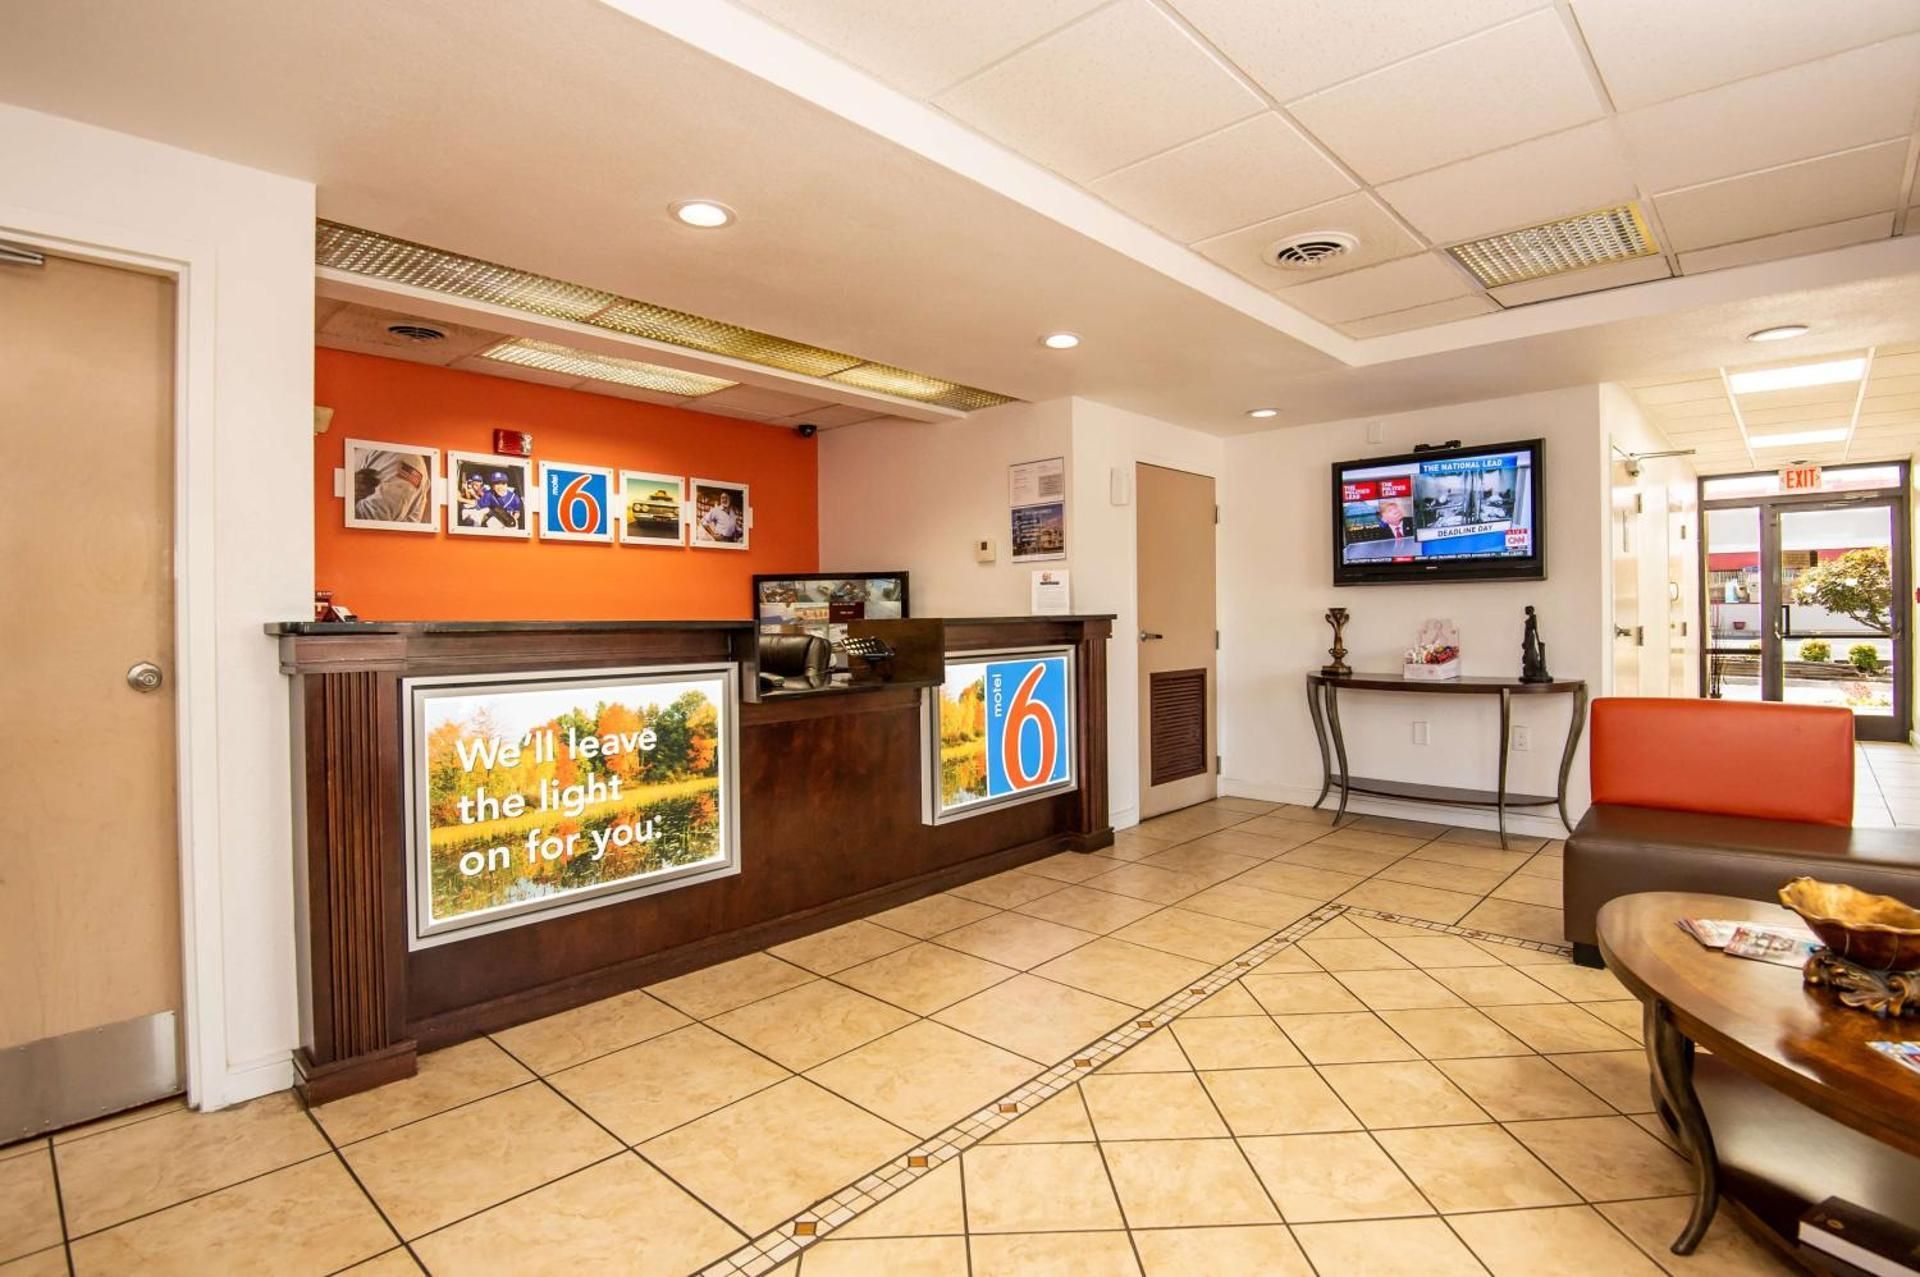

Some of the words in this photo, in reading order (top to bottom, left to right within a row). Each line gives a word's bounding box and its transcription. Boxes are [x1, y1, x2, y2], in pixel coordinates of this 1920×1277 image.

[1423, 464, 1440, 473] THE
[1441, 460, 1480, 471] NATIONAL
[1482, 458, 1503, 468] LEAD
[1786, 468, 1816, 489] EXIT
[557, 473, 601, 535] 6
[1437, 526, 1477, 537] DEADLINE
[1478, 524, 1493, 533] DAY
[1507, 535, 1525, 544] CNN
[992, 673, 1002, 718] motel
[456, 728, 554, 773] We'll
[567, 726, 658, 761] leave
[1002, 662, 1058, 792] 6
[457, 786, 526, 825] the
[540, 772, 624, 818] light
[458, 844, 510, 877] on
[526, 828, 580, 864] for
